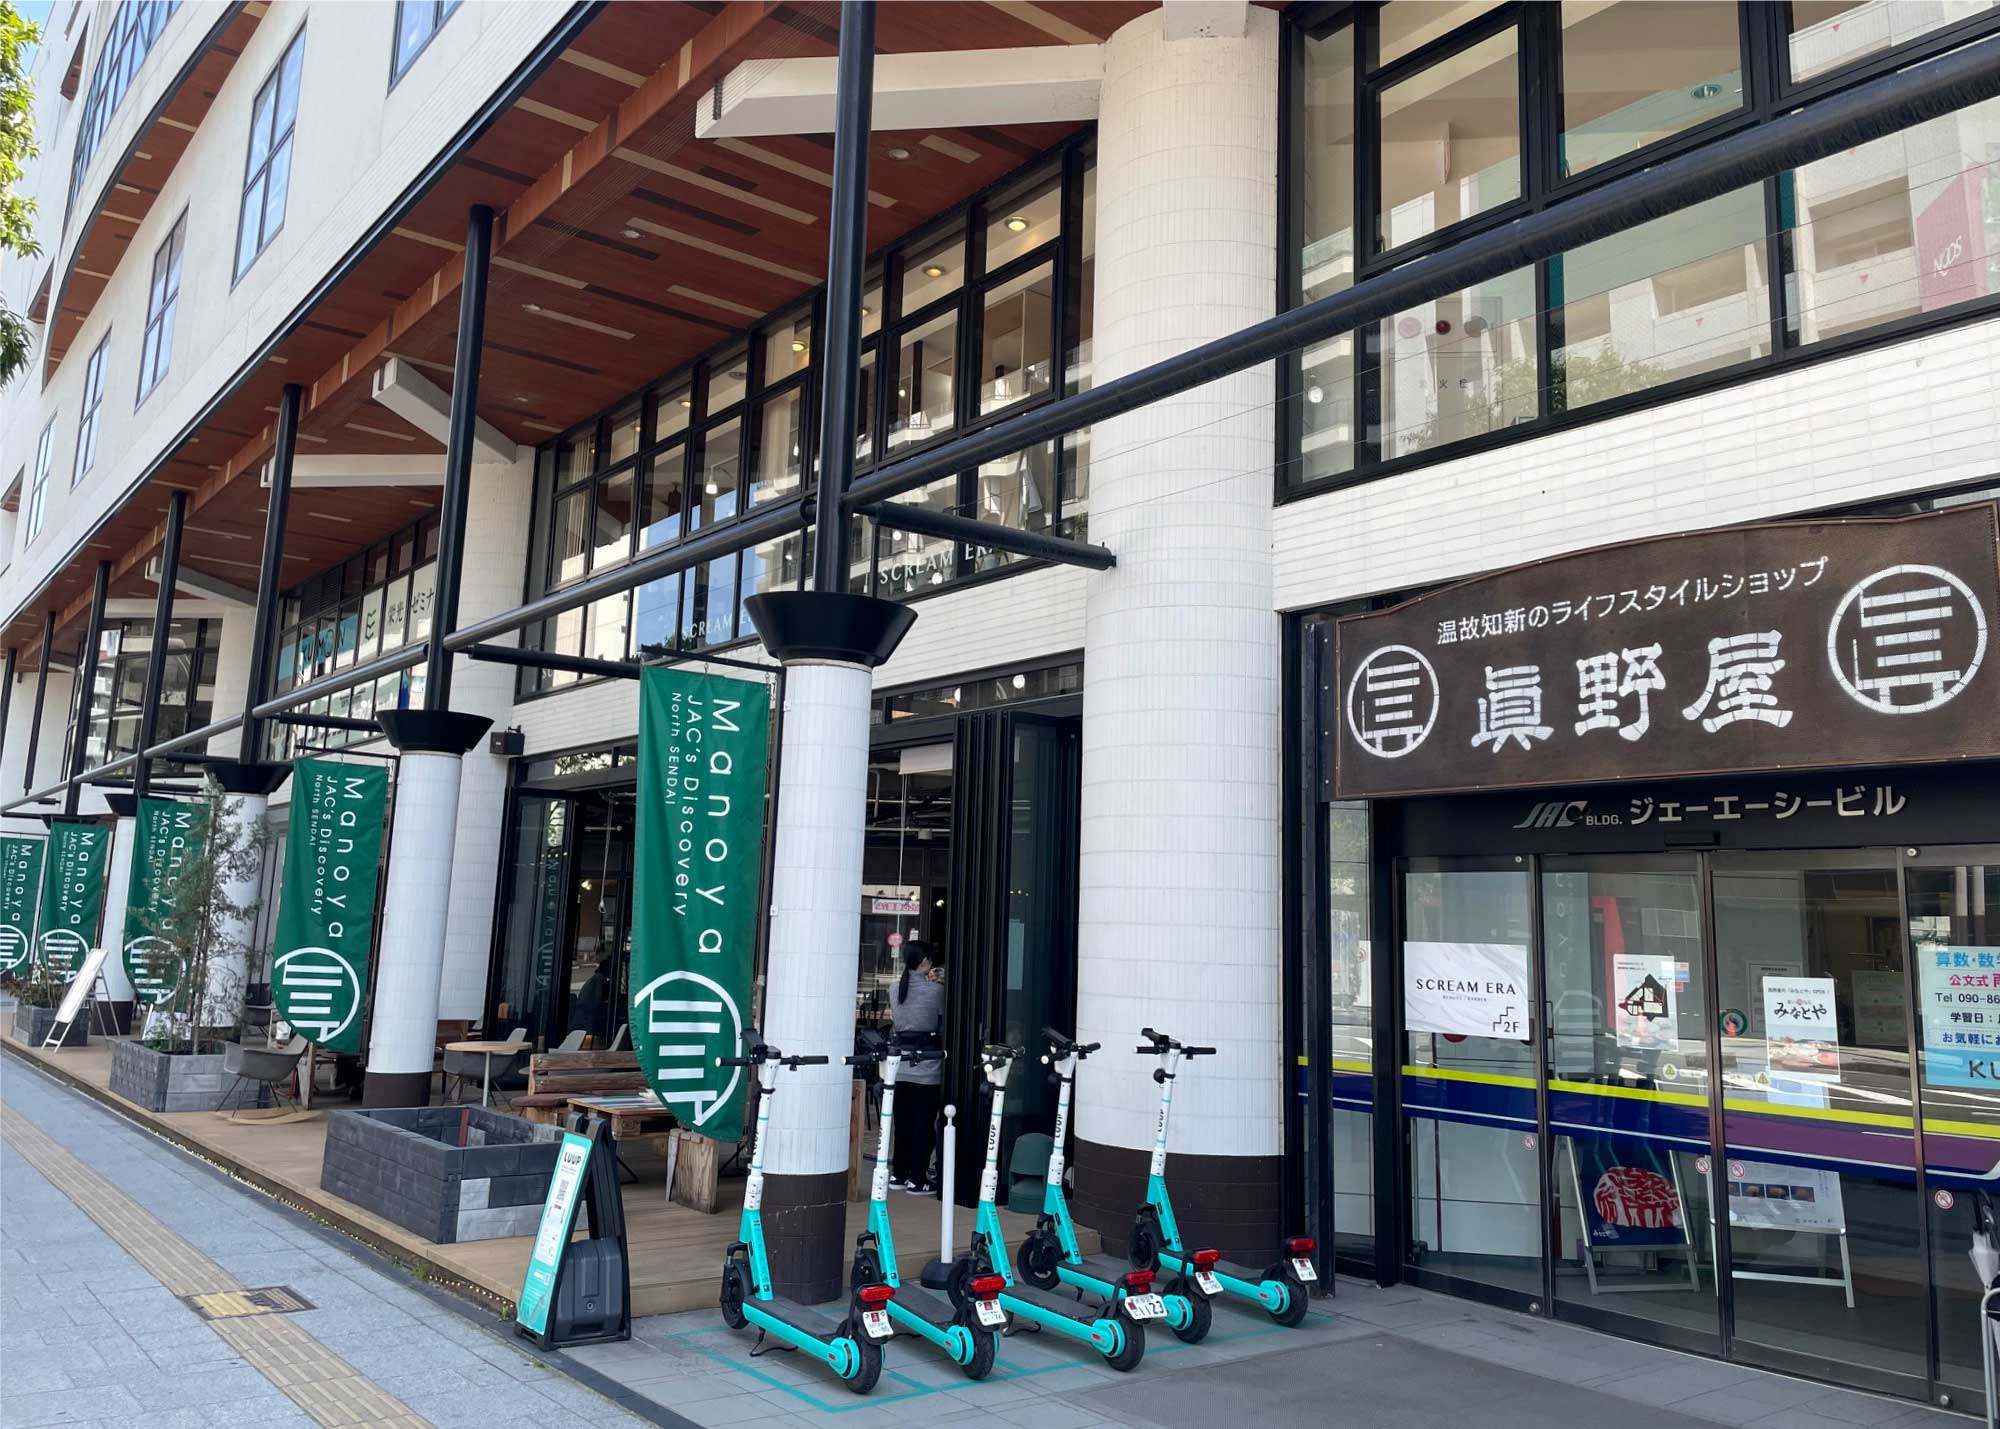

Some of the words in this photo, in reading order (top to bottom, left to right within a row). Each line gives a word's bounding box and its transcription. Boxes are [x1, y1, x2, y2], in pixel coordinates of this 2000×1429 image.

[880, 547, 954, 584] SCREAM
[1436, 555, 1829, 645] 温故知新のライフスタイルショップ
[1470, 628, 1794, 754] 眞野屋
[671, 692, 682, 737] North
[684, 695, 703, 763] JAC's
[312, 774, 323, 804] North
[664, 745, 680, 806] SENDAI
[322, 776, 338, 821] JAC's
[1586, 814, 1623, 827] BLDG.
[1629, 785, 1907, 826] ジェーエーシービル
[308, 808, 320, 846] SENDAI
[673, 776, 699, 916] Discovery
[696, 698, 741, 954] Manoya
[70, 832, 95, 924] Manoya
[311, 828, 332, 916] Discovery
[326, 776, 366, 938] Manoya
[11, 844, 33, 921] Manoya
[1416, 978, 1478, 993] SCREAM
[1486, 982, 1516, 995] ERA
[1935, 992, 1952, 1003] Tel
[1949, 974, 1989, 988] 公文式
[1503, 1021, 1520, 1033] 2F
[1774, 1002, 1828, 1020] みなとや
[563, 1151, 582, 1166] LUUP
